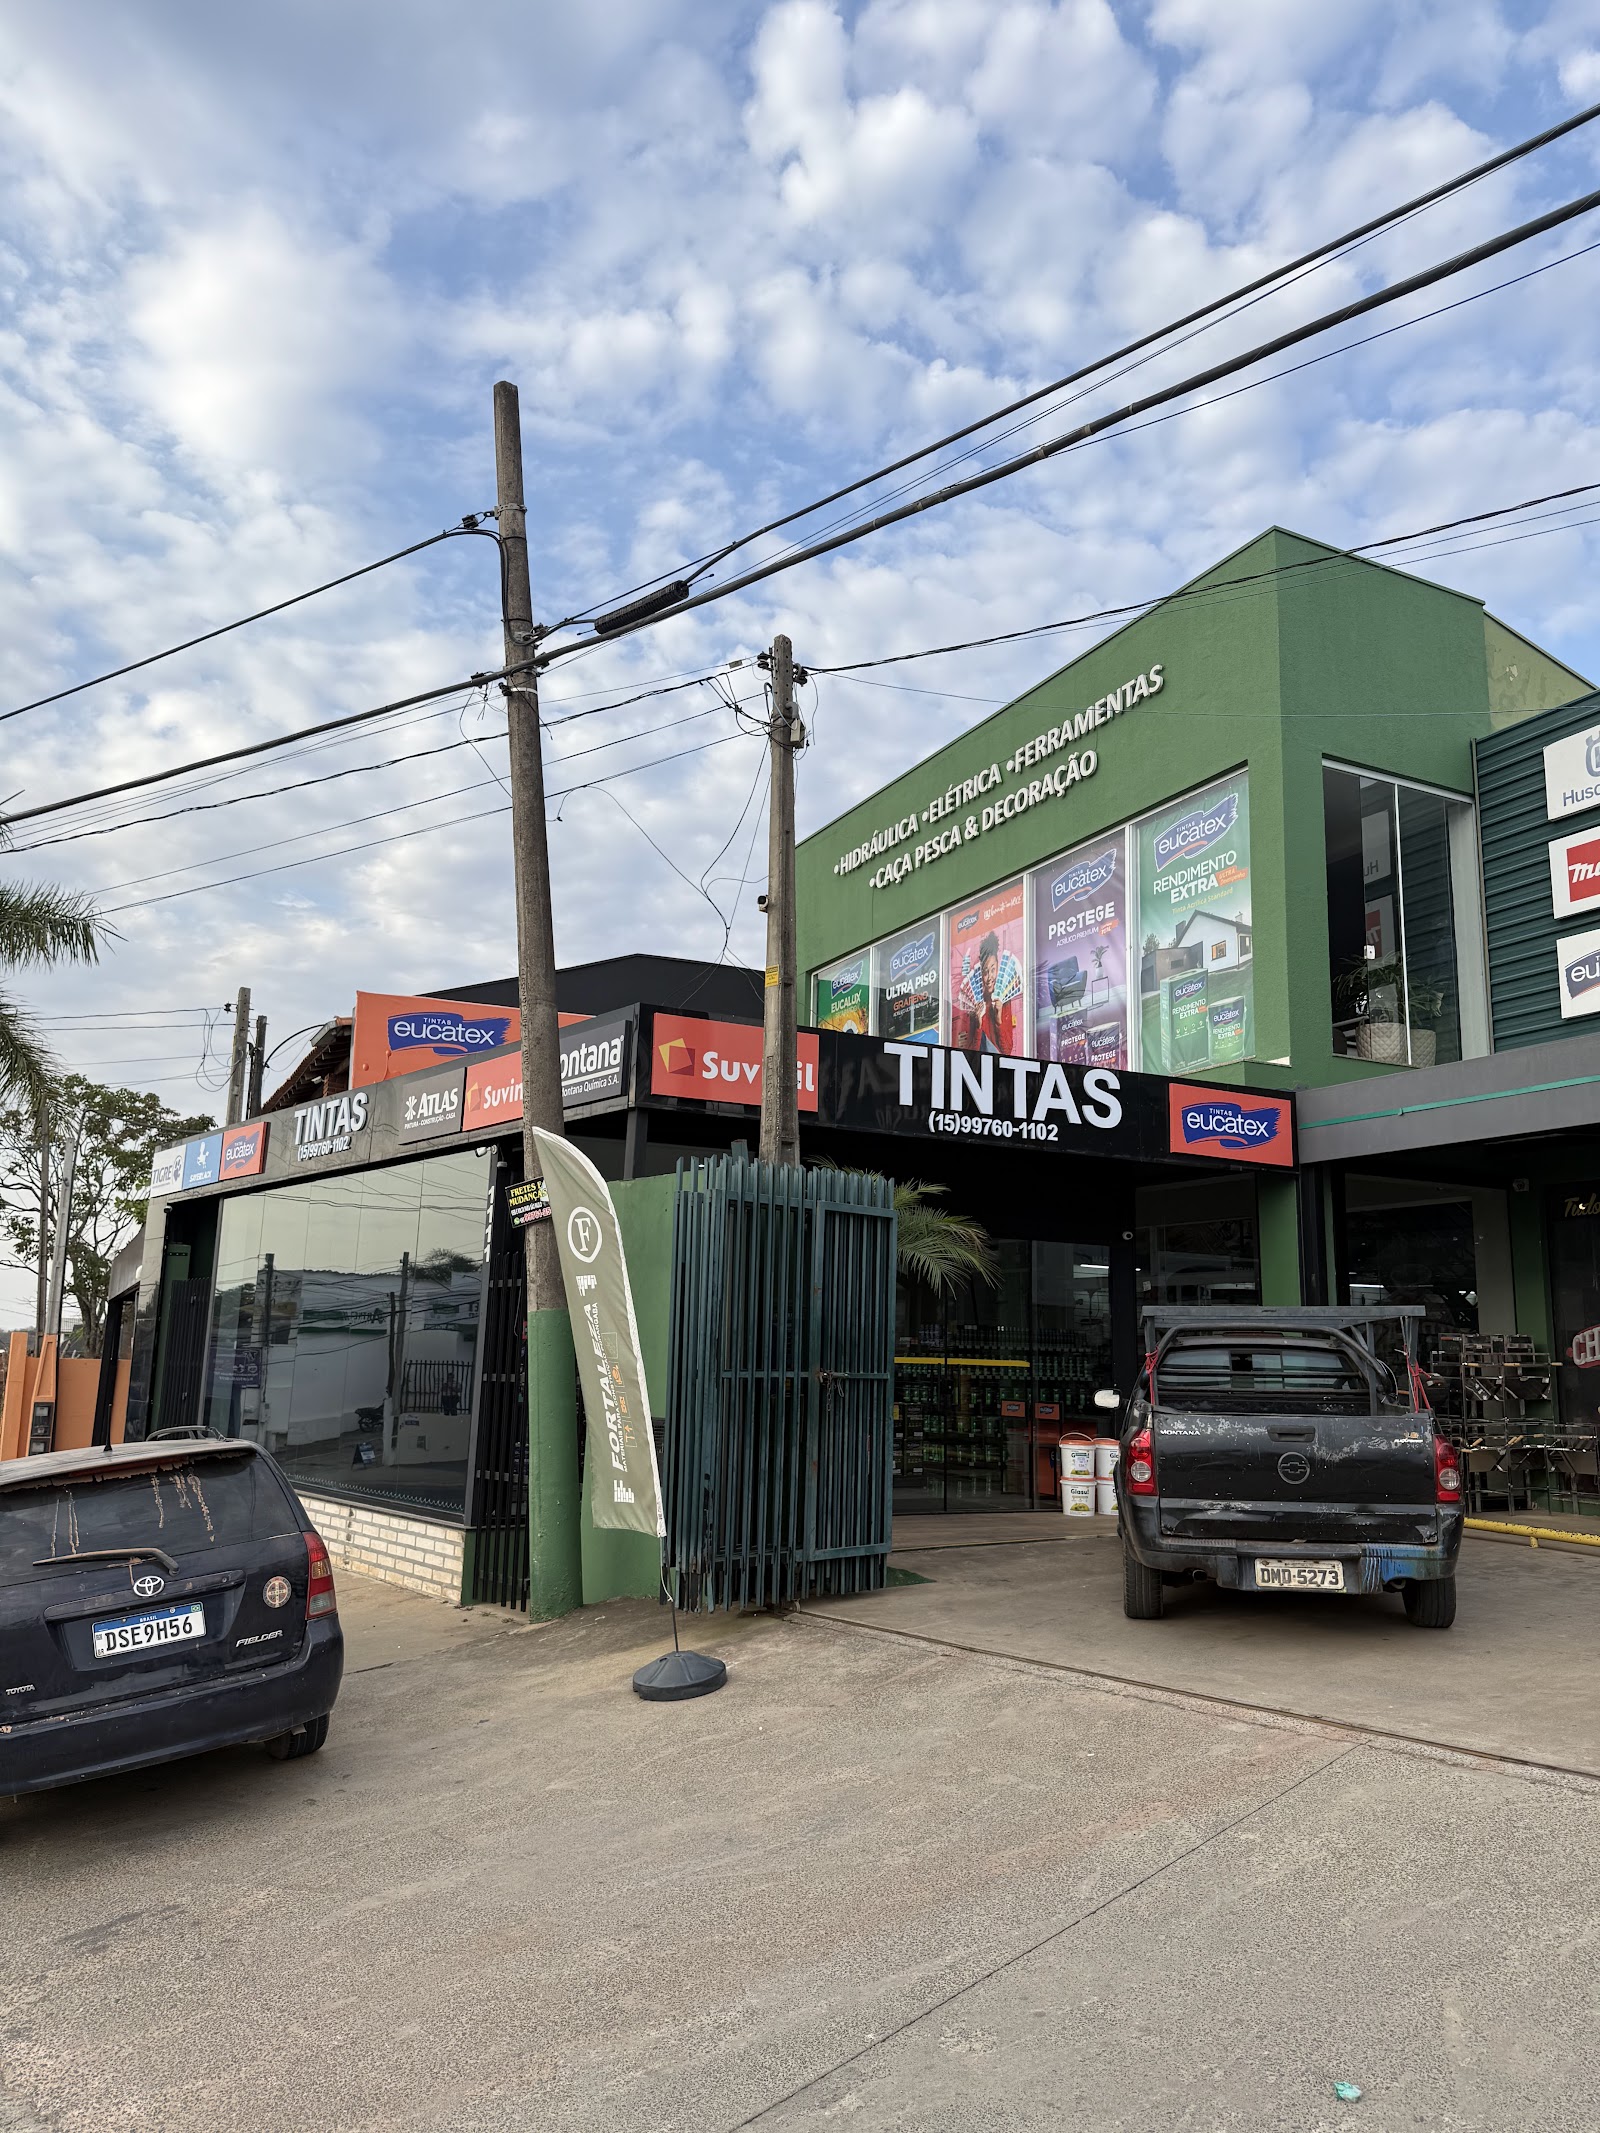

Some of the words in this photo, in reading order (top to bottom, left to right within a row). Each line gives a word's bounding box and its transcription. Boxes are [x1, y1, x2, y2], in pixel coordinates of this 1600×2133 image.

[839, 813, 919, 876] HIDRÁULICA
[929, 763, 1002, 823] ELÉTRICA
[1015, 664, 1164, 773] FERRAMENTAS
[875, 853, 913, 889] CAÇA
[915, 825, 961, 869] PESCA
[964, 815, 979, 840] &
[982, 750, 1097, 831] DECORAÇÃO
[1158, 813, 1227, 854] eucatex
[1055, 865, 1107, 896] eucatex
[1153, 850, 1237, 895] RENDIMENTO
[1170, 874, 1219, 904] EXTRA
[1048, 901, 1115, 940] PROTEGE
[1077, 926, 1099, 939] PREMIUM
[892, 945, 929, 969] eucatex
[832, 970, 859, 989] eucatex
[886, 979, 915, 1000] ULTRA
[915, 970, 937, 989] PISO
[1175, 981, 1203, 997] eucatex
[831, 989, 862, 1013] EUCALUX
[1172, 998, 1207, 1016] RENDIMENTO
[423, 1016, 452, 1026] TINTAS
[1179, 1008, 1200, 1020] EXTRA
[1213, 1009, 1240, 1022] eucatex
[393, 1020, 495, 1046] eucatex
[1061, 1033, 1086, 1047] PROTEGE
[1212, 1022, 1241, 1034] RENDIMENTO
[1217, 1031, 1235, 1040] EXTRA
[560, 1038, 622, 1079] ontana
[1091, 1050, 1116, 1062] PROTEGE
[584, 1077, 607, 1092] Química
[608, 1074, 620, 1086] S.A.
[702, 1051, 815, 1092] Suvil
[483, 1077, 524, 1109] Suvin
[883, 1041, 1122, 1129] TINTAS
[416, 1087, 459, 1119] ATLAS
[1209, 1106, 1233, 1117] TINTAS
[294, 1092, 368, 1145] TINTAS
[404, 1121, 419, 1130] PINTURA
[446, 1111, 456, 1121] CASA
[928, 1109, 1059, 1142] (15)99760-1102
[1186, 1109, 1270, 1140] eucatex
[225, 1141, 254, 1161] eucatex
[298, 1136, 350, 1162] (15)99760-1102
[152, 1164, 172, 1185] TIGRE
[509, 1188, 548, 1207] MUDANÇAS
[510, 1182, 536, 1198] FRETES
[575, 1217, 591, 1252] F
[584, 1303, 626, 1472] FORTALEZA
[614, 1407, 623, 1428] PARA
[616, 1429, 628, 1473] MATERIAIS
[139, 1614, 158, 1623] BRASIL
[105, 1616, 193, 1652] DSE9H56
[235, 1629, 283, 1648] FIELDER
[6, 1684, 36, 1695] TOYOTA
